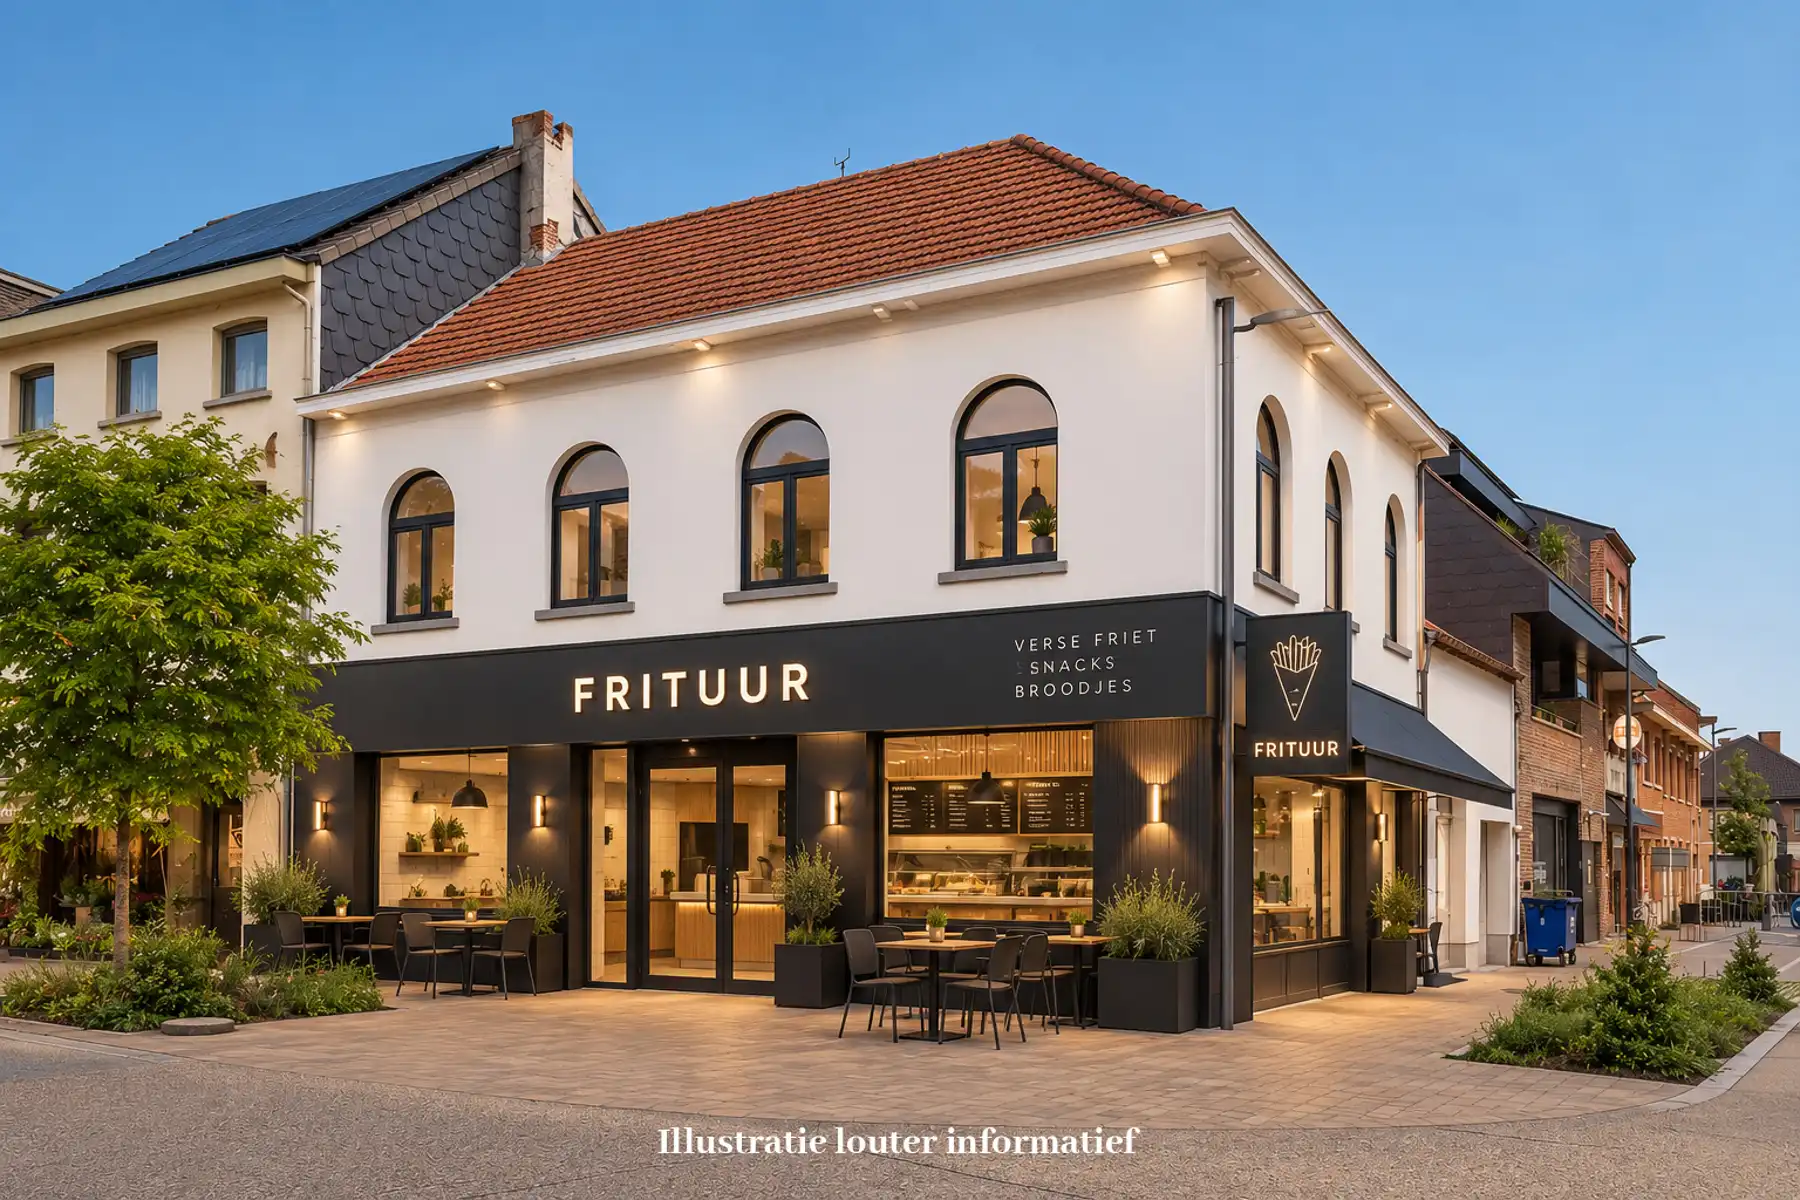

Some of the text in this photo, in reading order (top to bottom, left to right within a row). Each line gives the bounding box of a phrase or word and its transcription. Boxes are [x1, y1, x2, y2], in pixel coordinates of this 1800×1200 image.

[1014, 628, 1157, 652] VERSE FRIET
[1029, 655, 1116, 675] SNACKS
[573, 662, 810, 714] FRITUUR
[1014, 678, 1132, 698] BROODJES
[1254, 740, 1339, 758] FRITUUR
